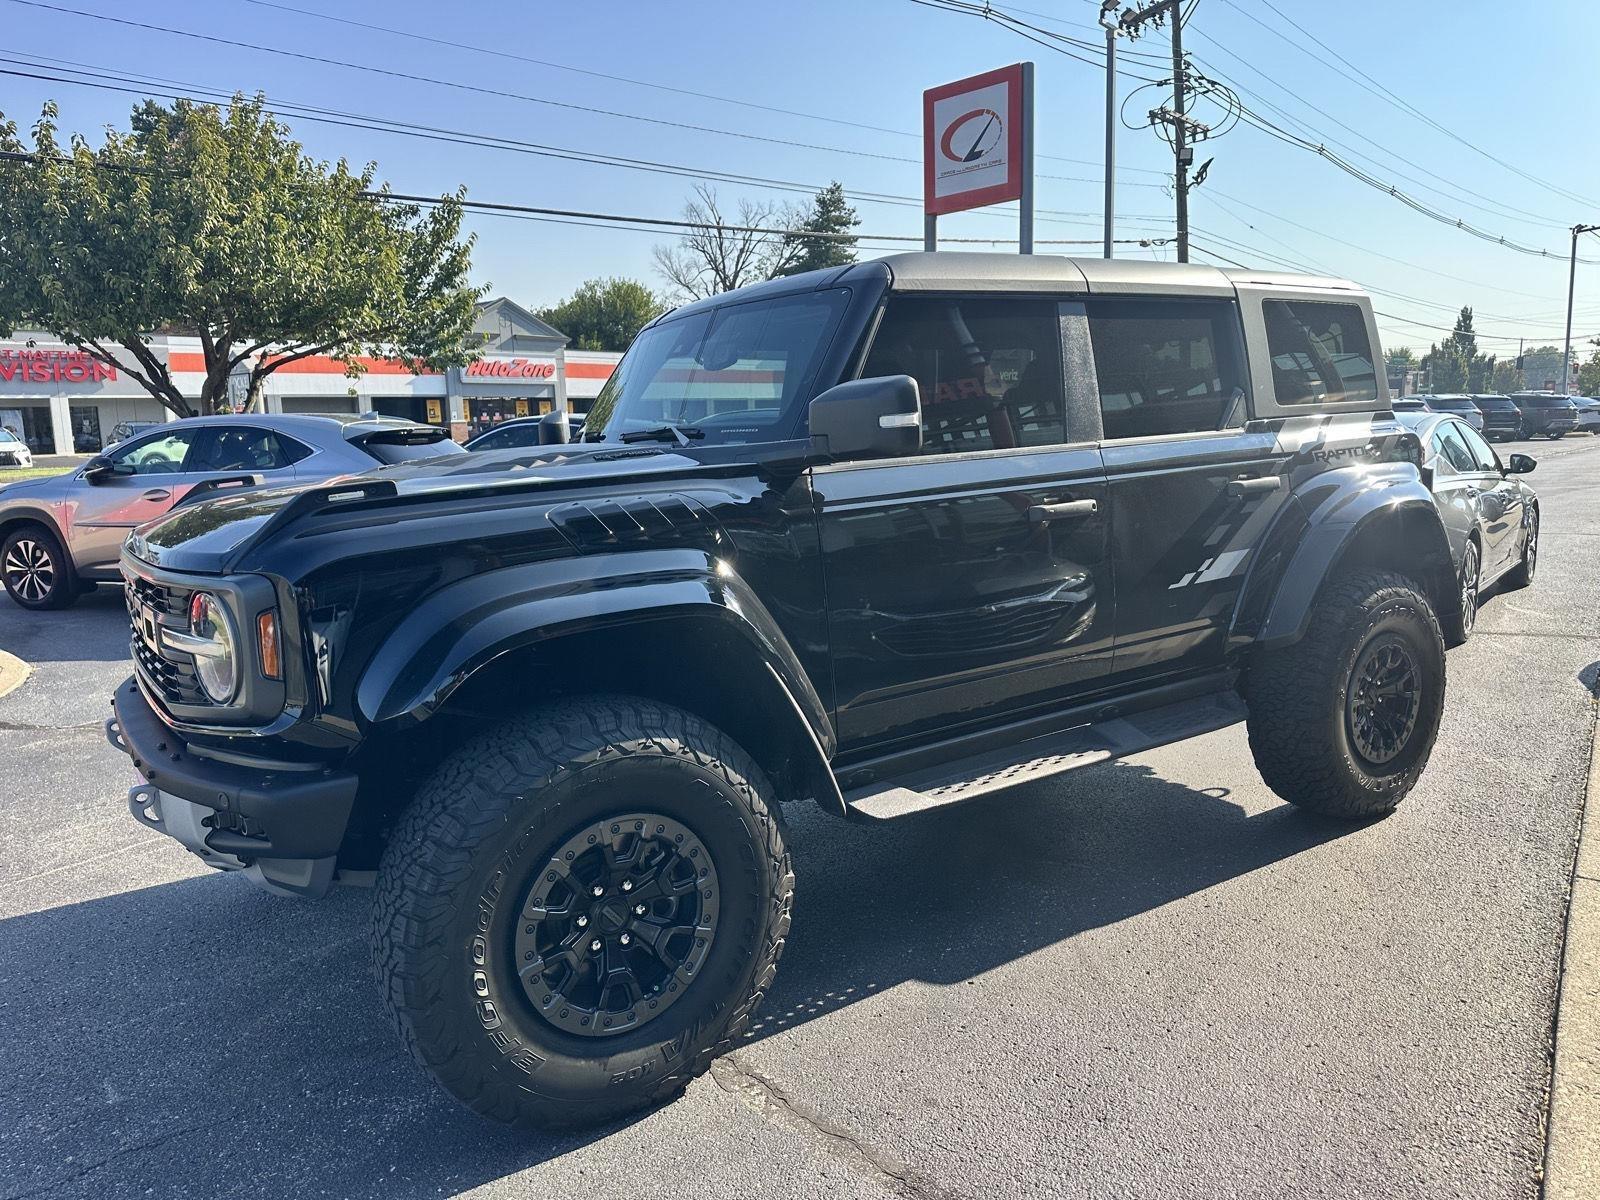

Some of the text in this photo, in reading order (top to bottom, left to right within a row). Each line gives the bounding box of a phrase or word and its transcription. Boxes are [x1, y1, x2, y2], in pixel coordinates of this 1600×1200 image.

[0, 348, 111, 362] T MATTHE
[0, 360, 118, 383] VISION
[467, 358, 555, 378] AutoZone
